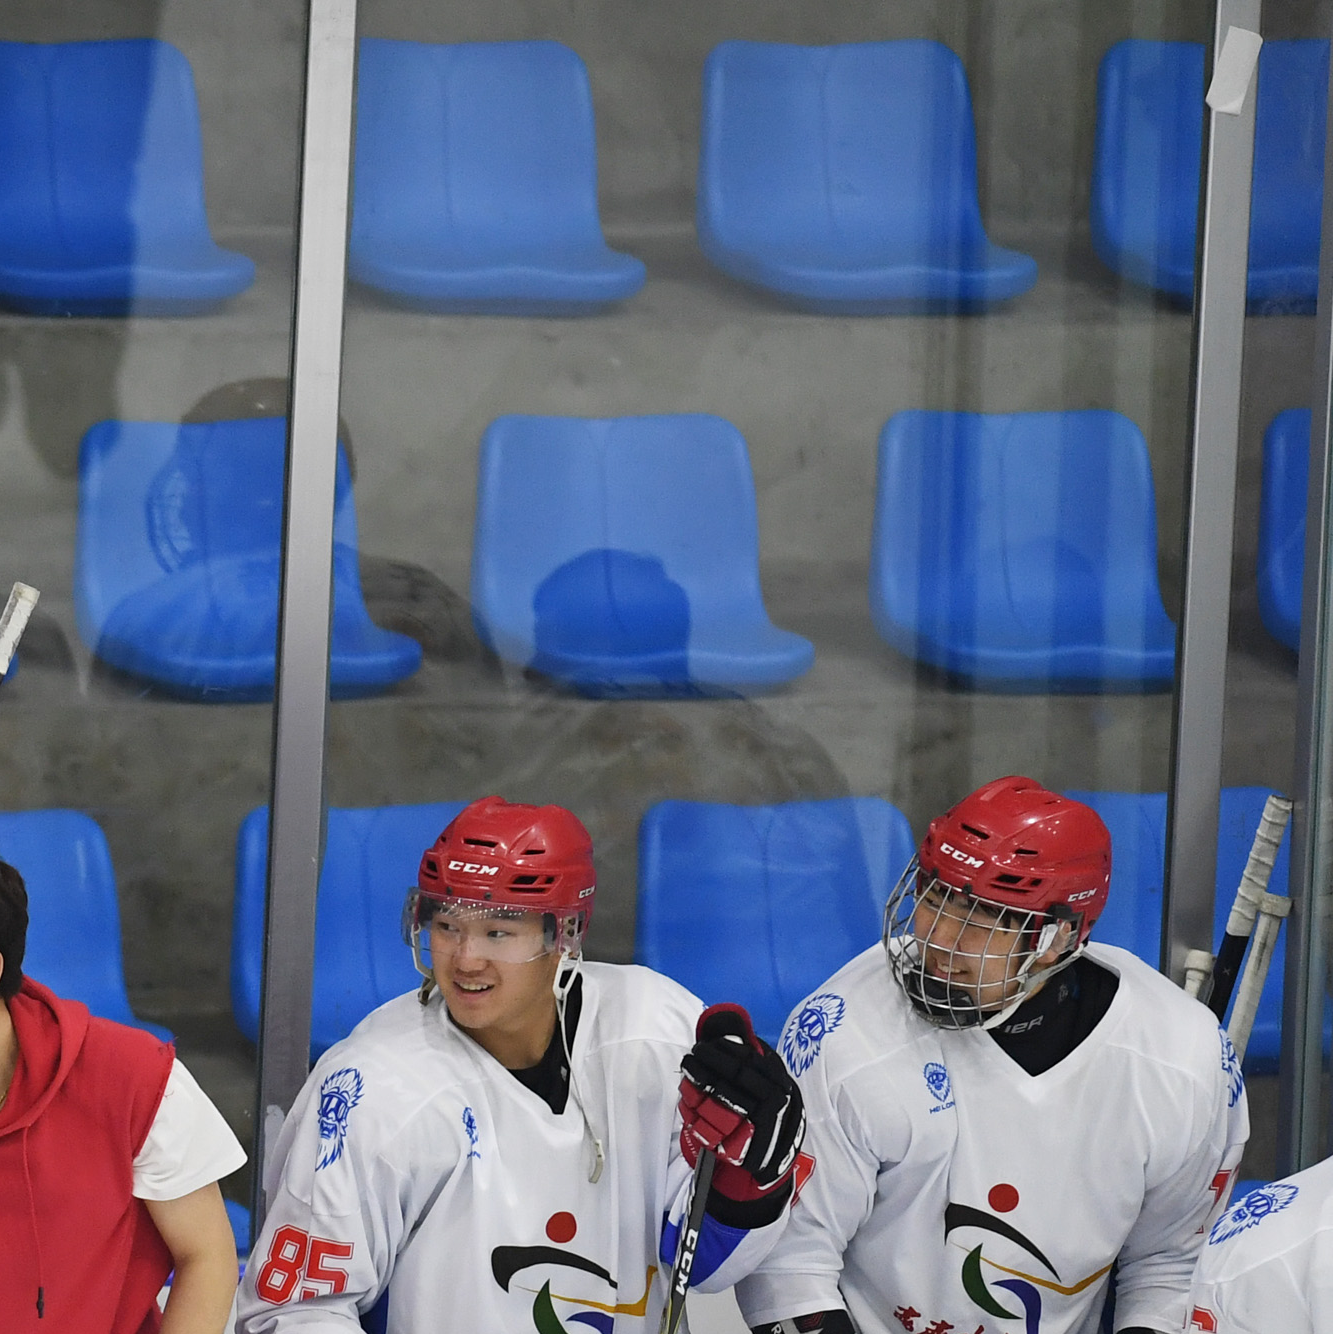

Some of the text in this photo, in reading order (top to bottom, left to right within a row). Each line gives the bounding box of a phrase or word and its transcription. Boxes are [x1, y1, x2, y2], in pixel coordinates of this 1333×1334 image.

[940, 842, 985, 869] CCM
[448, 860, 499, 876] CCM
[578, 885, 596, 899] CCM
[1067, 888, 1098, 903] CCM
[254, 1223, 356, 1306] 85
[674, 1228, 700, 1297] CCM
